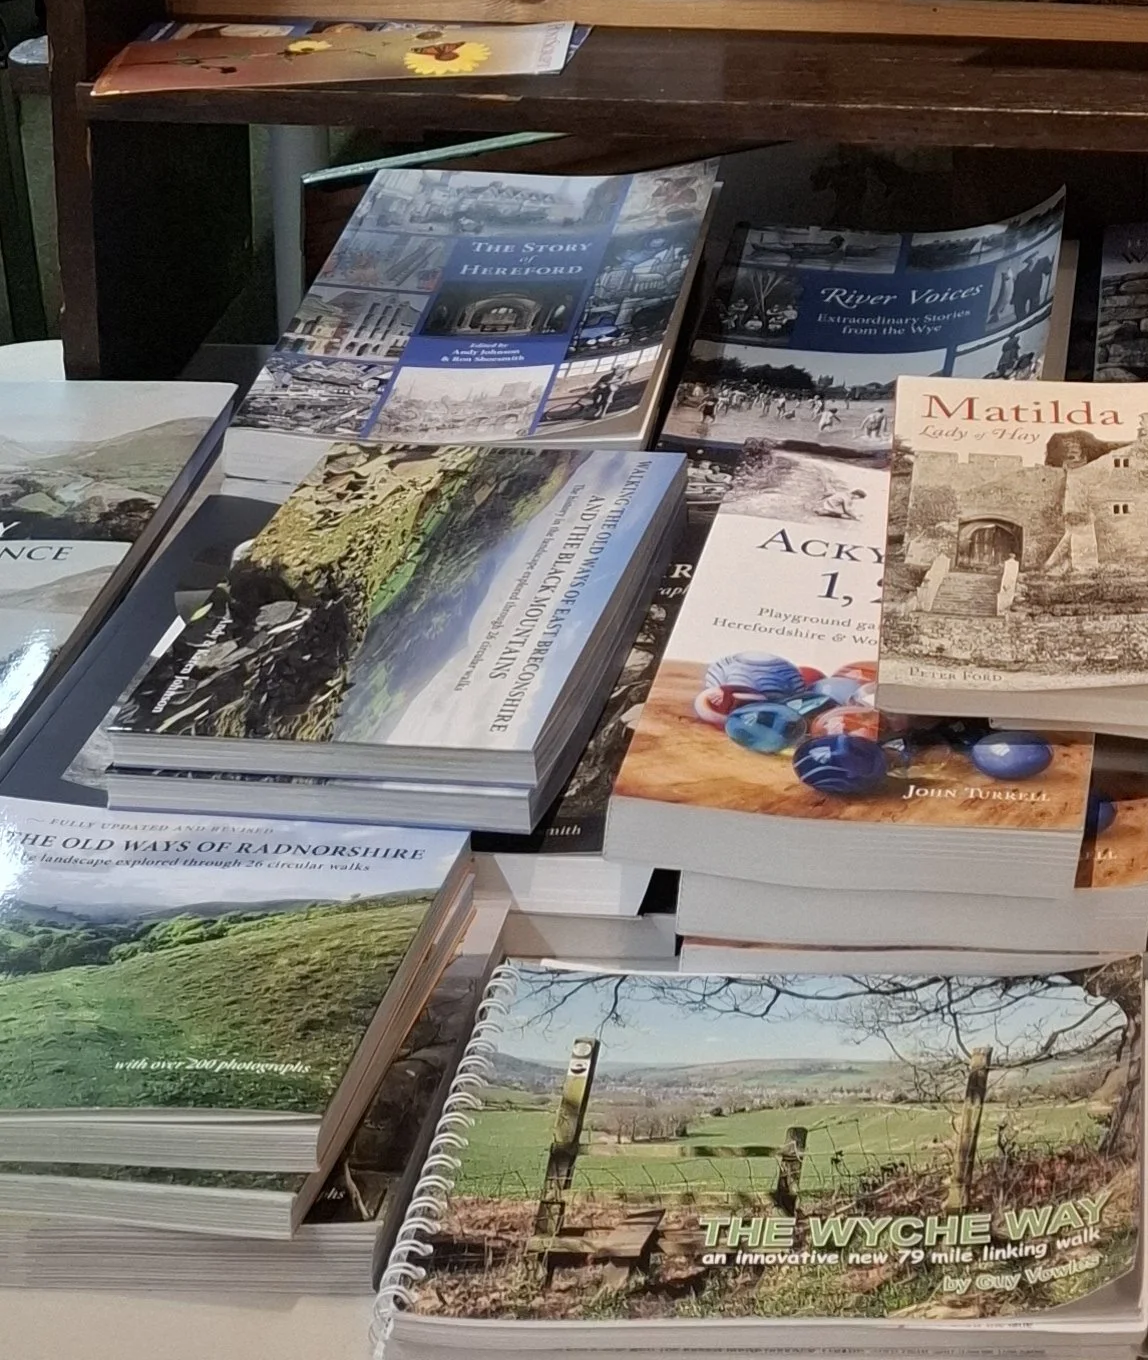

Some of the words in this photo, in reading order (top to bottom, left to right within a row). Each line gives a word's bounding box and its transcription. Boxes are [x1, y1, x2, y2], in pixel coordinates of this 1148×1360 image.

[471, 241, 517, 255] THE
[521, 240, 594, 255] STORY
[519, 254, 536, 266] of
[459, 264, 583, 276] HEREFORD
[819, 286, 898, 308] River
[908, 281, 984, 303] Voices
[921, 393, 1125, 426] Matilda
[757, 528, 887, 562] ACKY
[901, 782, 958, 802] JOHN
[964, 785, 1051, 804] TURRELL
[61, 835, 116, 853] OLD
[123, 836, 191, 854] WAYS
[196, 840, 232, 854] OF
[236, 841, 427, 862] RADNORSHIRE
[699, 1214, 797, 1249] THE
[806, 1211, 994, 1249] WYCHE
[1003, 1192, 1114, 1242] WAY
